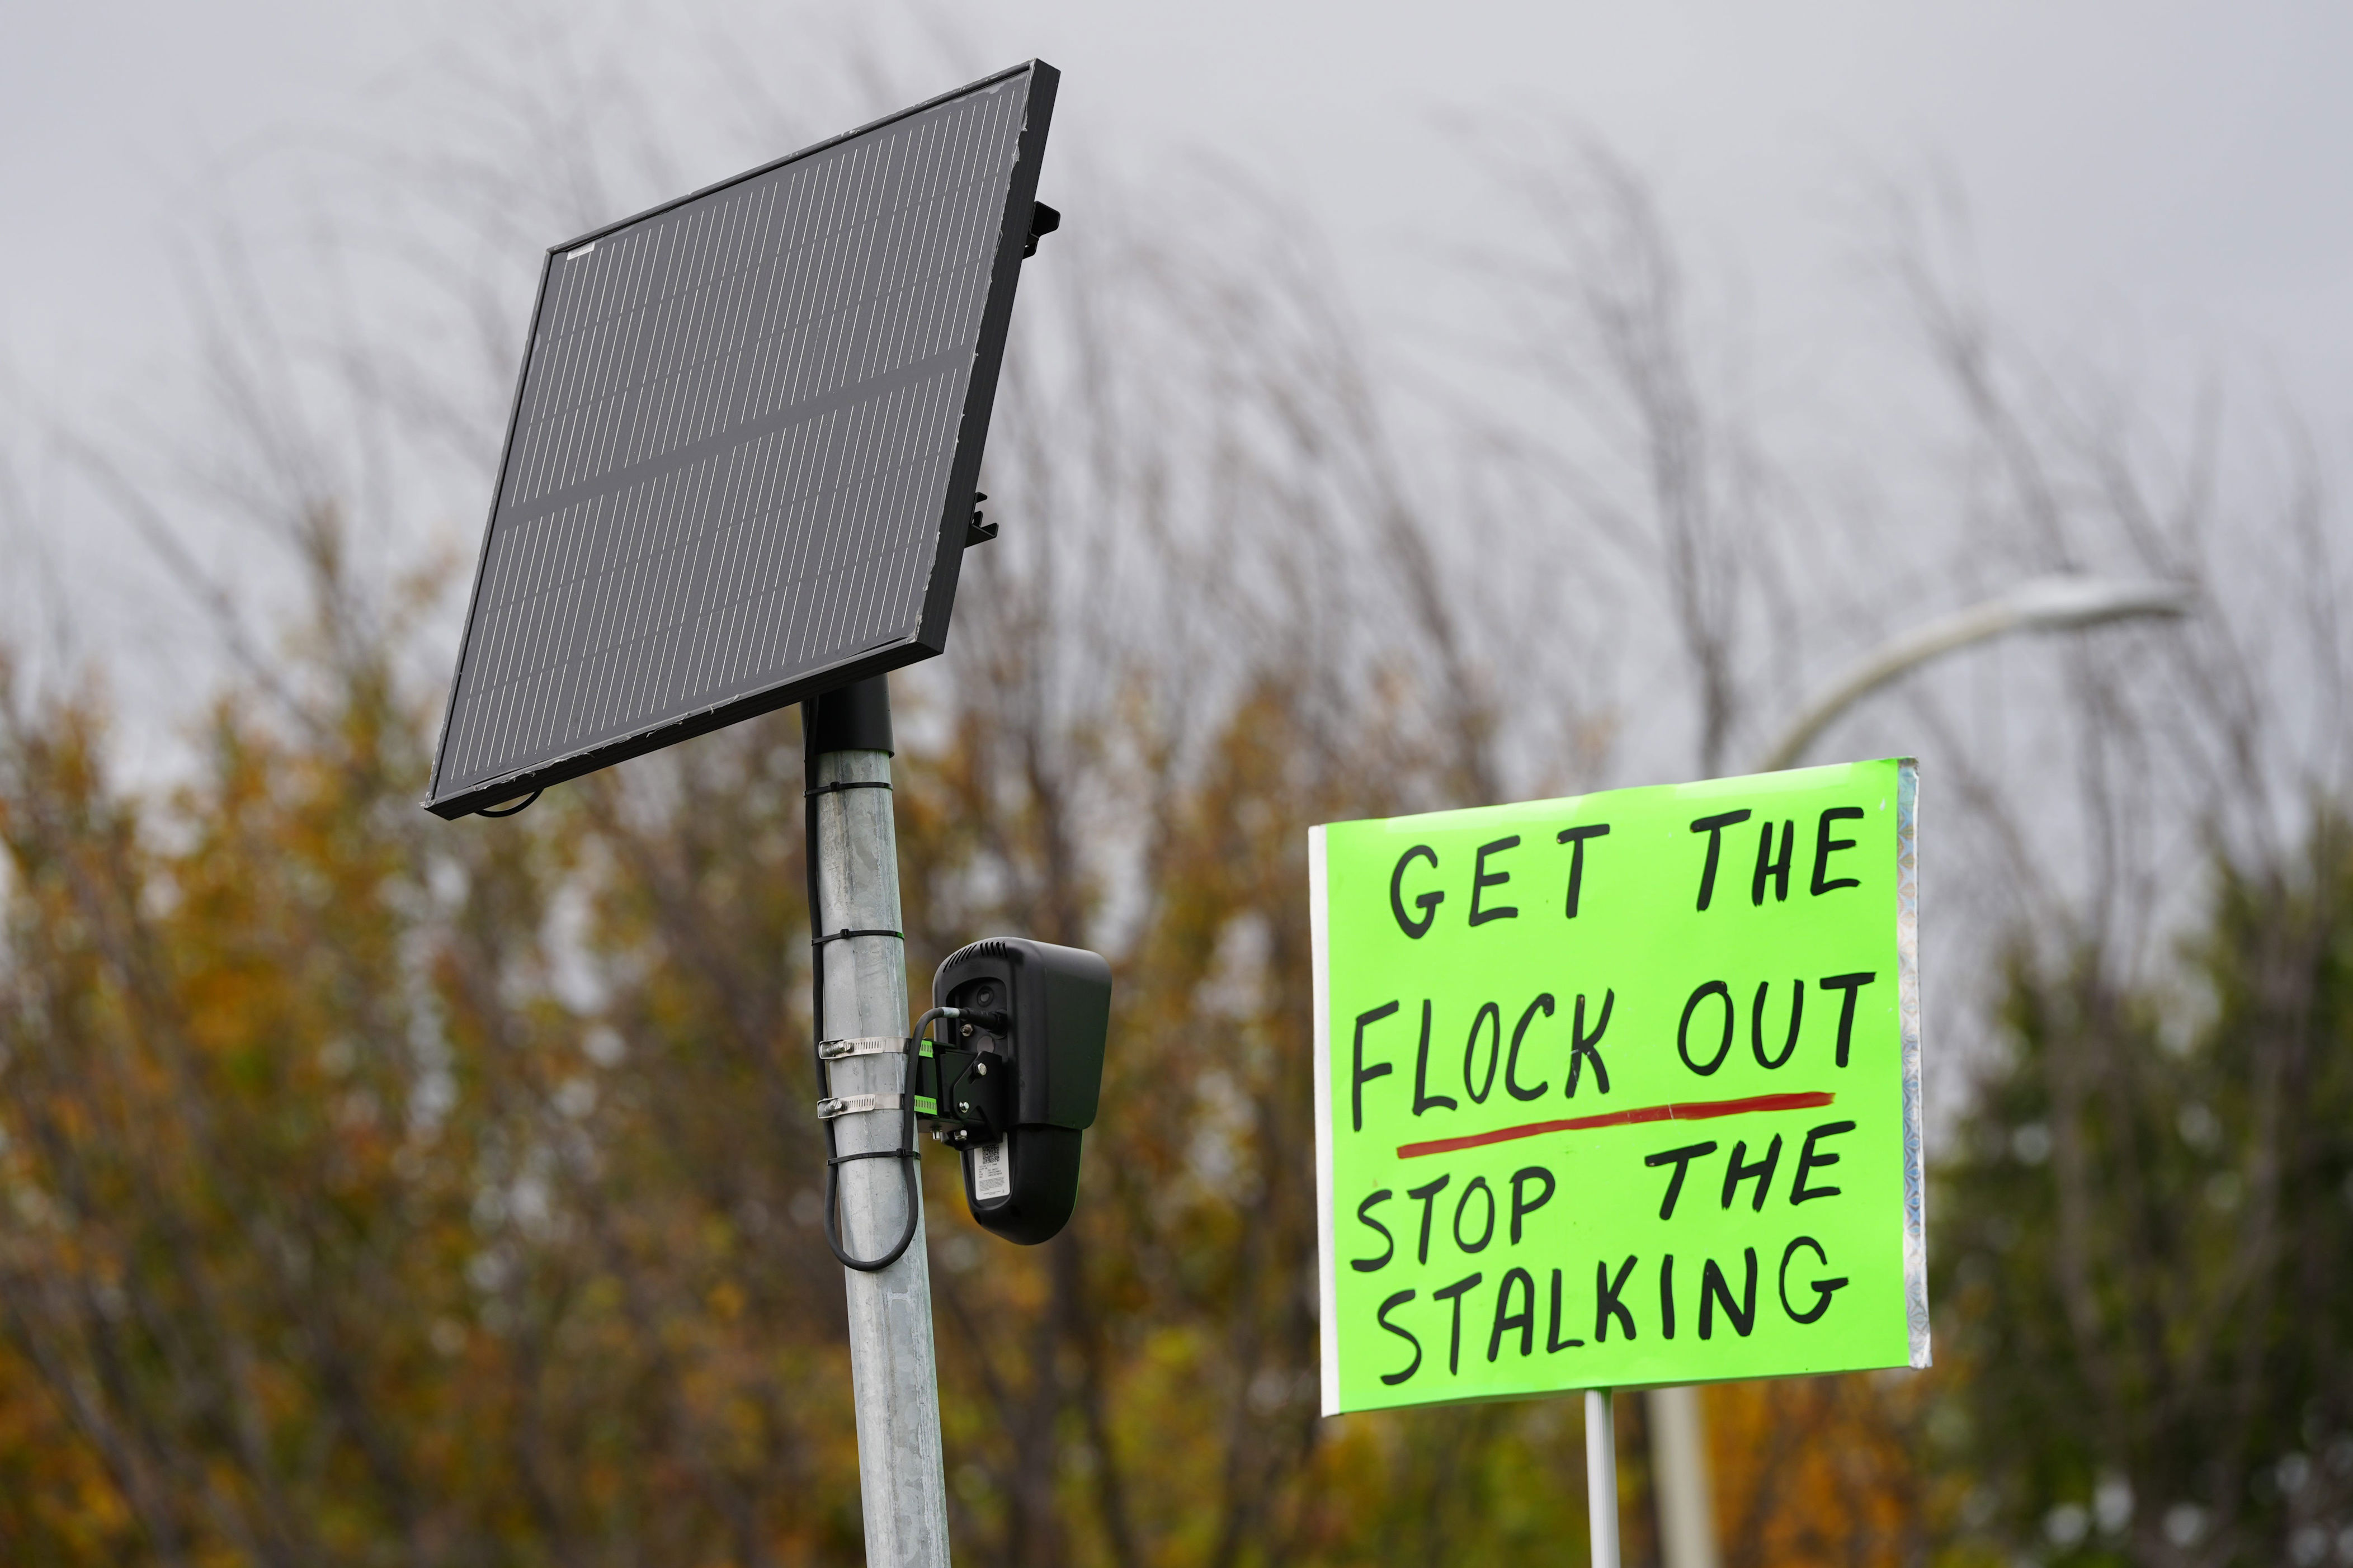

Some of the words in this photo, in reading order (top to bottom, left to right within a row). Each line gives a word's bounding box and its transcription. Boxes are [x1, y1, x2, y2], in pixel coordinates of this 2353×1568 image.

[1390, 824, 1610, 939] GET
[1690, 807, 1864, 911] THE
[1352, 989, 1614, 1132] FLOCK
[1677, 972, 1876, 1076] OUT
[1351, 1166, 1555, 1273] STOP
[1644, 1121, 1856, 1221] THE
[1378, 1236, 1849, 1386] STALKING
